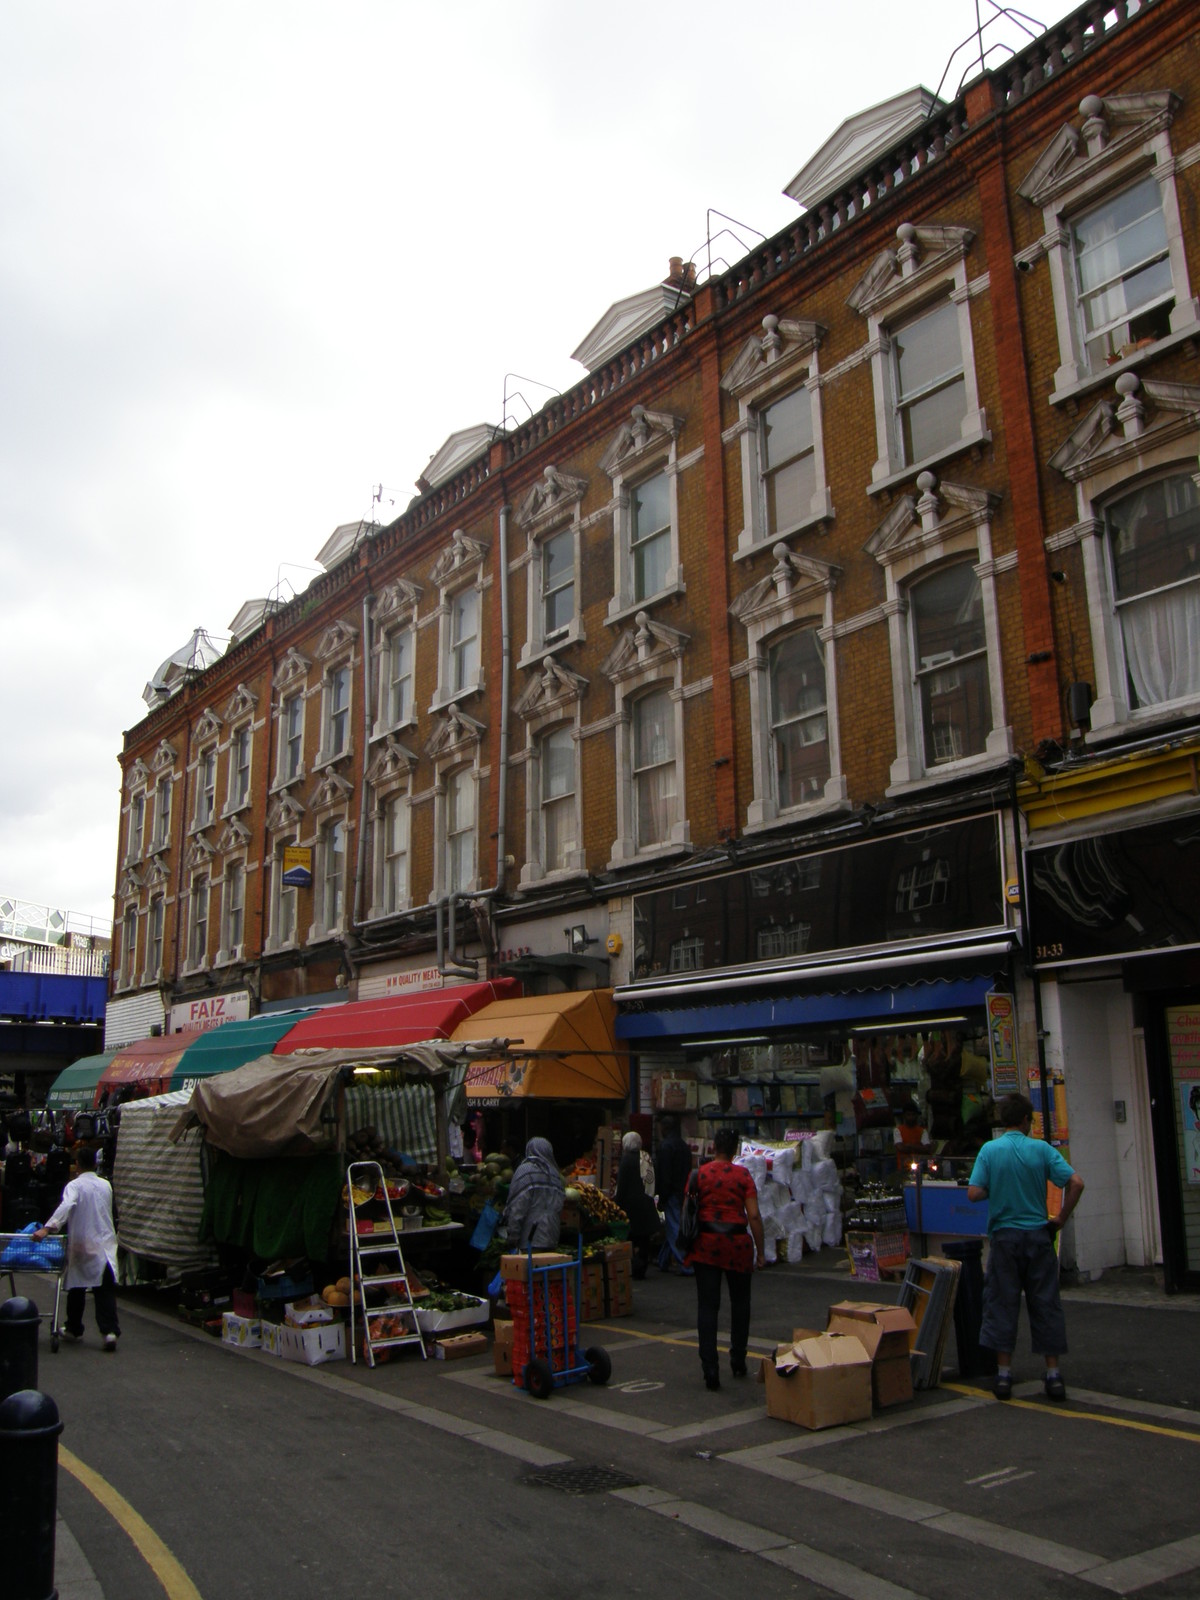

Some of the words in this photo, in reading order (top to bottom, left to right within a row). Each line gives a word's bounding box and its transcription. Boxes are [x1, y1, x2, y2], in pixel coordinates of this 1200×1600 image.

[1035, 943, 1063, 959] 31-33
[399, 971, 421, 987] QUALITY
[422, 968, 441, 982] MEATS
[190, 998, 225, 1021] FAIZ
[482, 1097, 500, 1107] CARRY
